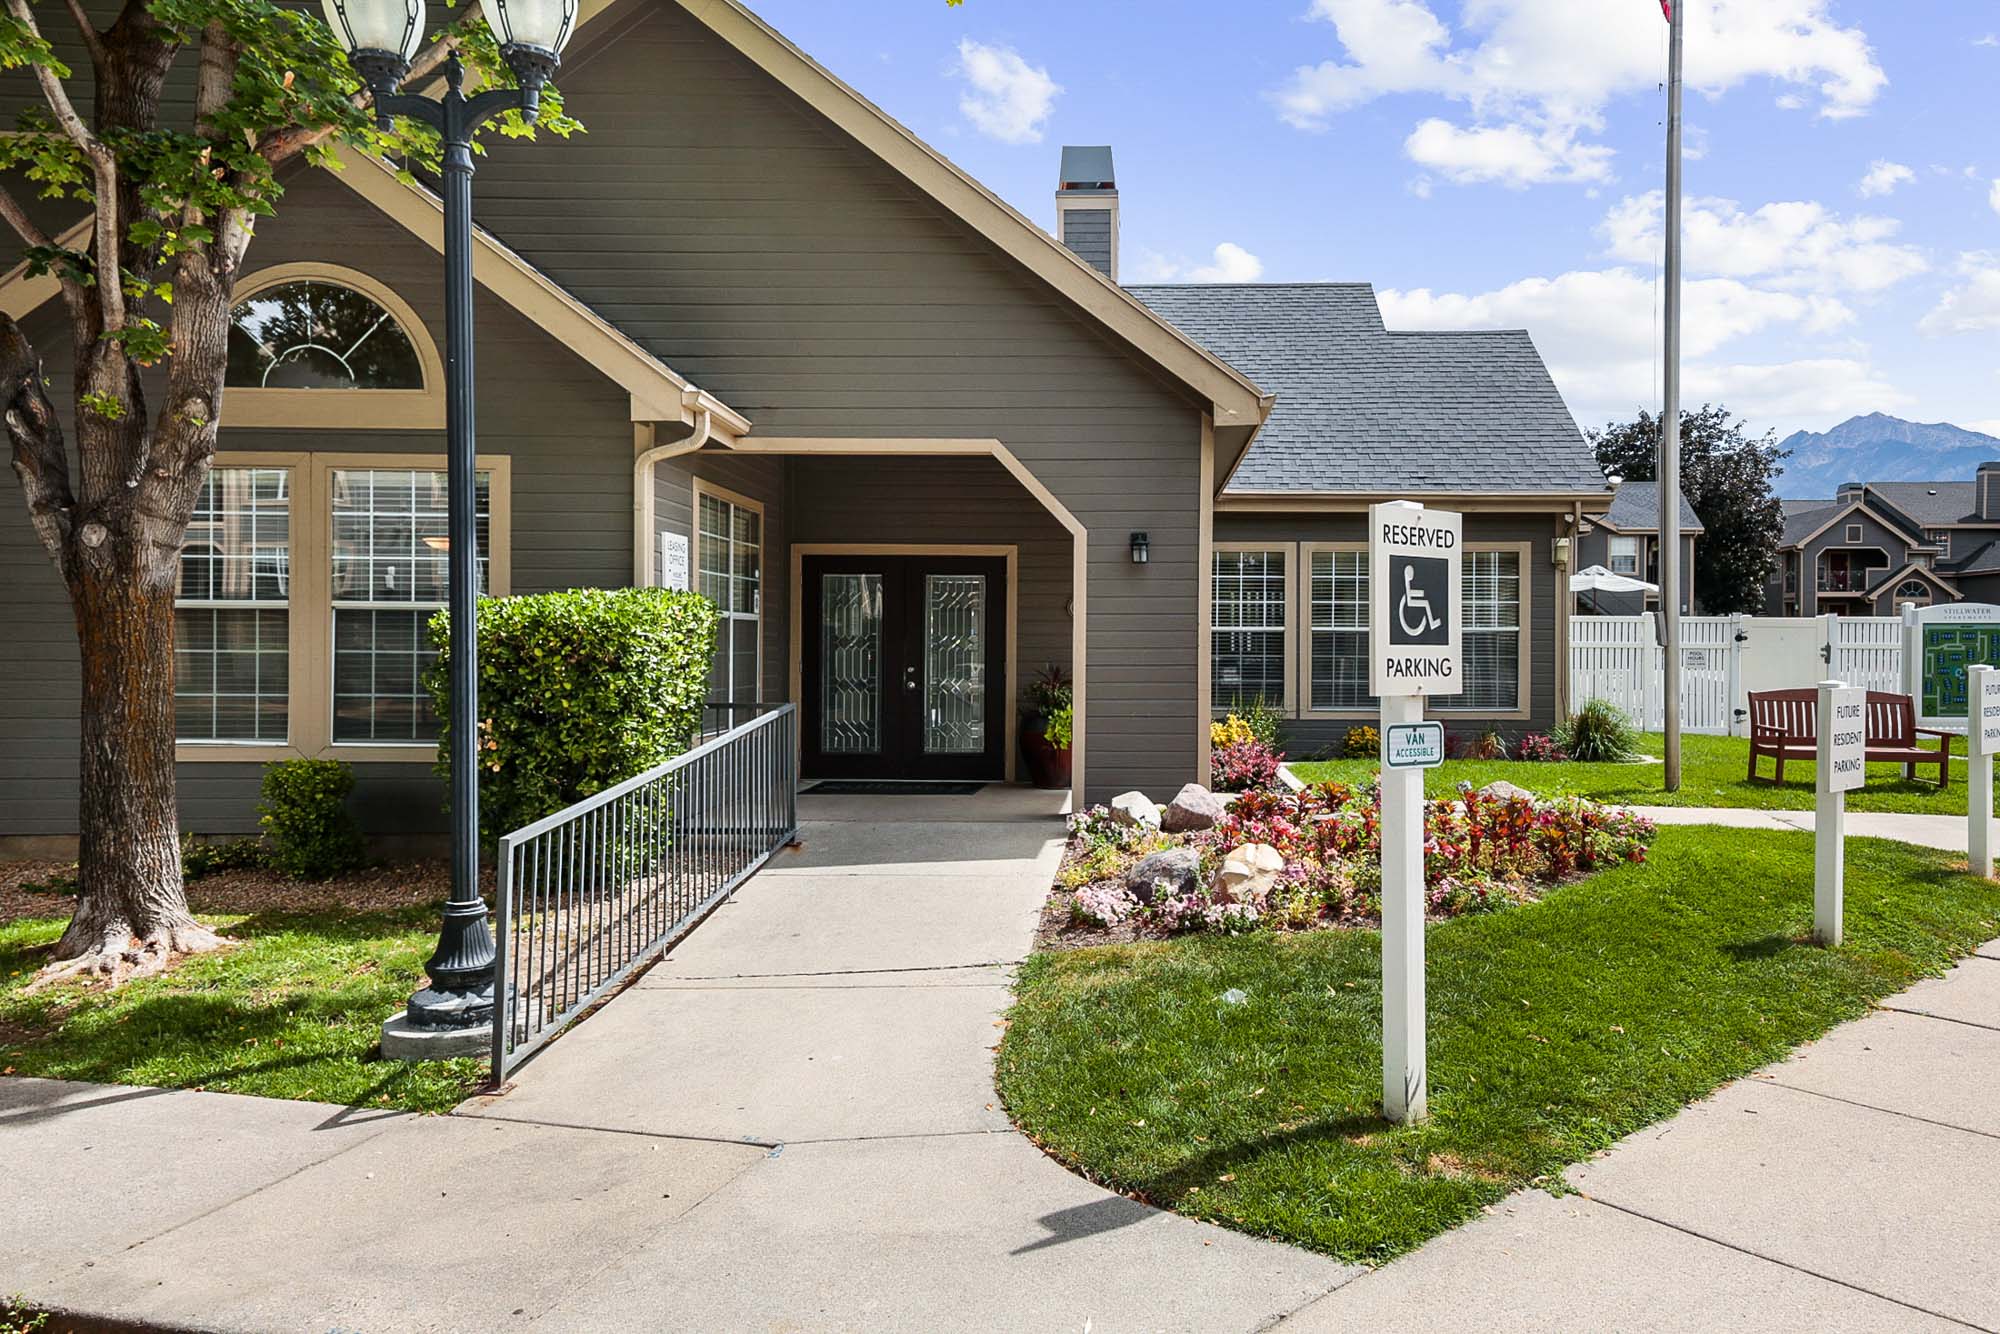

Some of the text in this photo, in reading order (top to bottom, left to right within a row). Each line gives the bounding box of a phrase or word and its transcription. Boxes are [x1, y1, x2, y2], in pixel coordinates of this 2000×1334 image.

[1383, 524, 1455, 549] RESERVED
[667, 540, 686, 553] LEASING
[669, 553, 685, 567] OFFICE
[1386, 658, 1452, 678] PARKING
[1836, 704, 1861, 719] FUTURE
[1405, 732, 1425, 745] VAN
[1833, 731, 1863, 747] RESIDENT
[1395, 747, 1435, 759] ACCESSIBLE
[1833, 758, 1861, 774] PARKING
